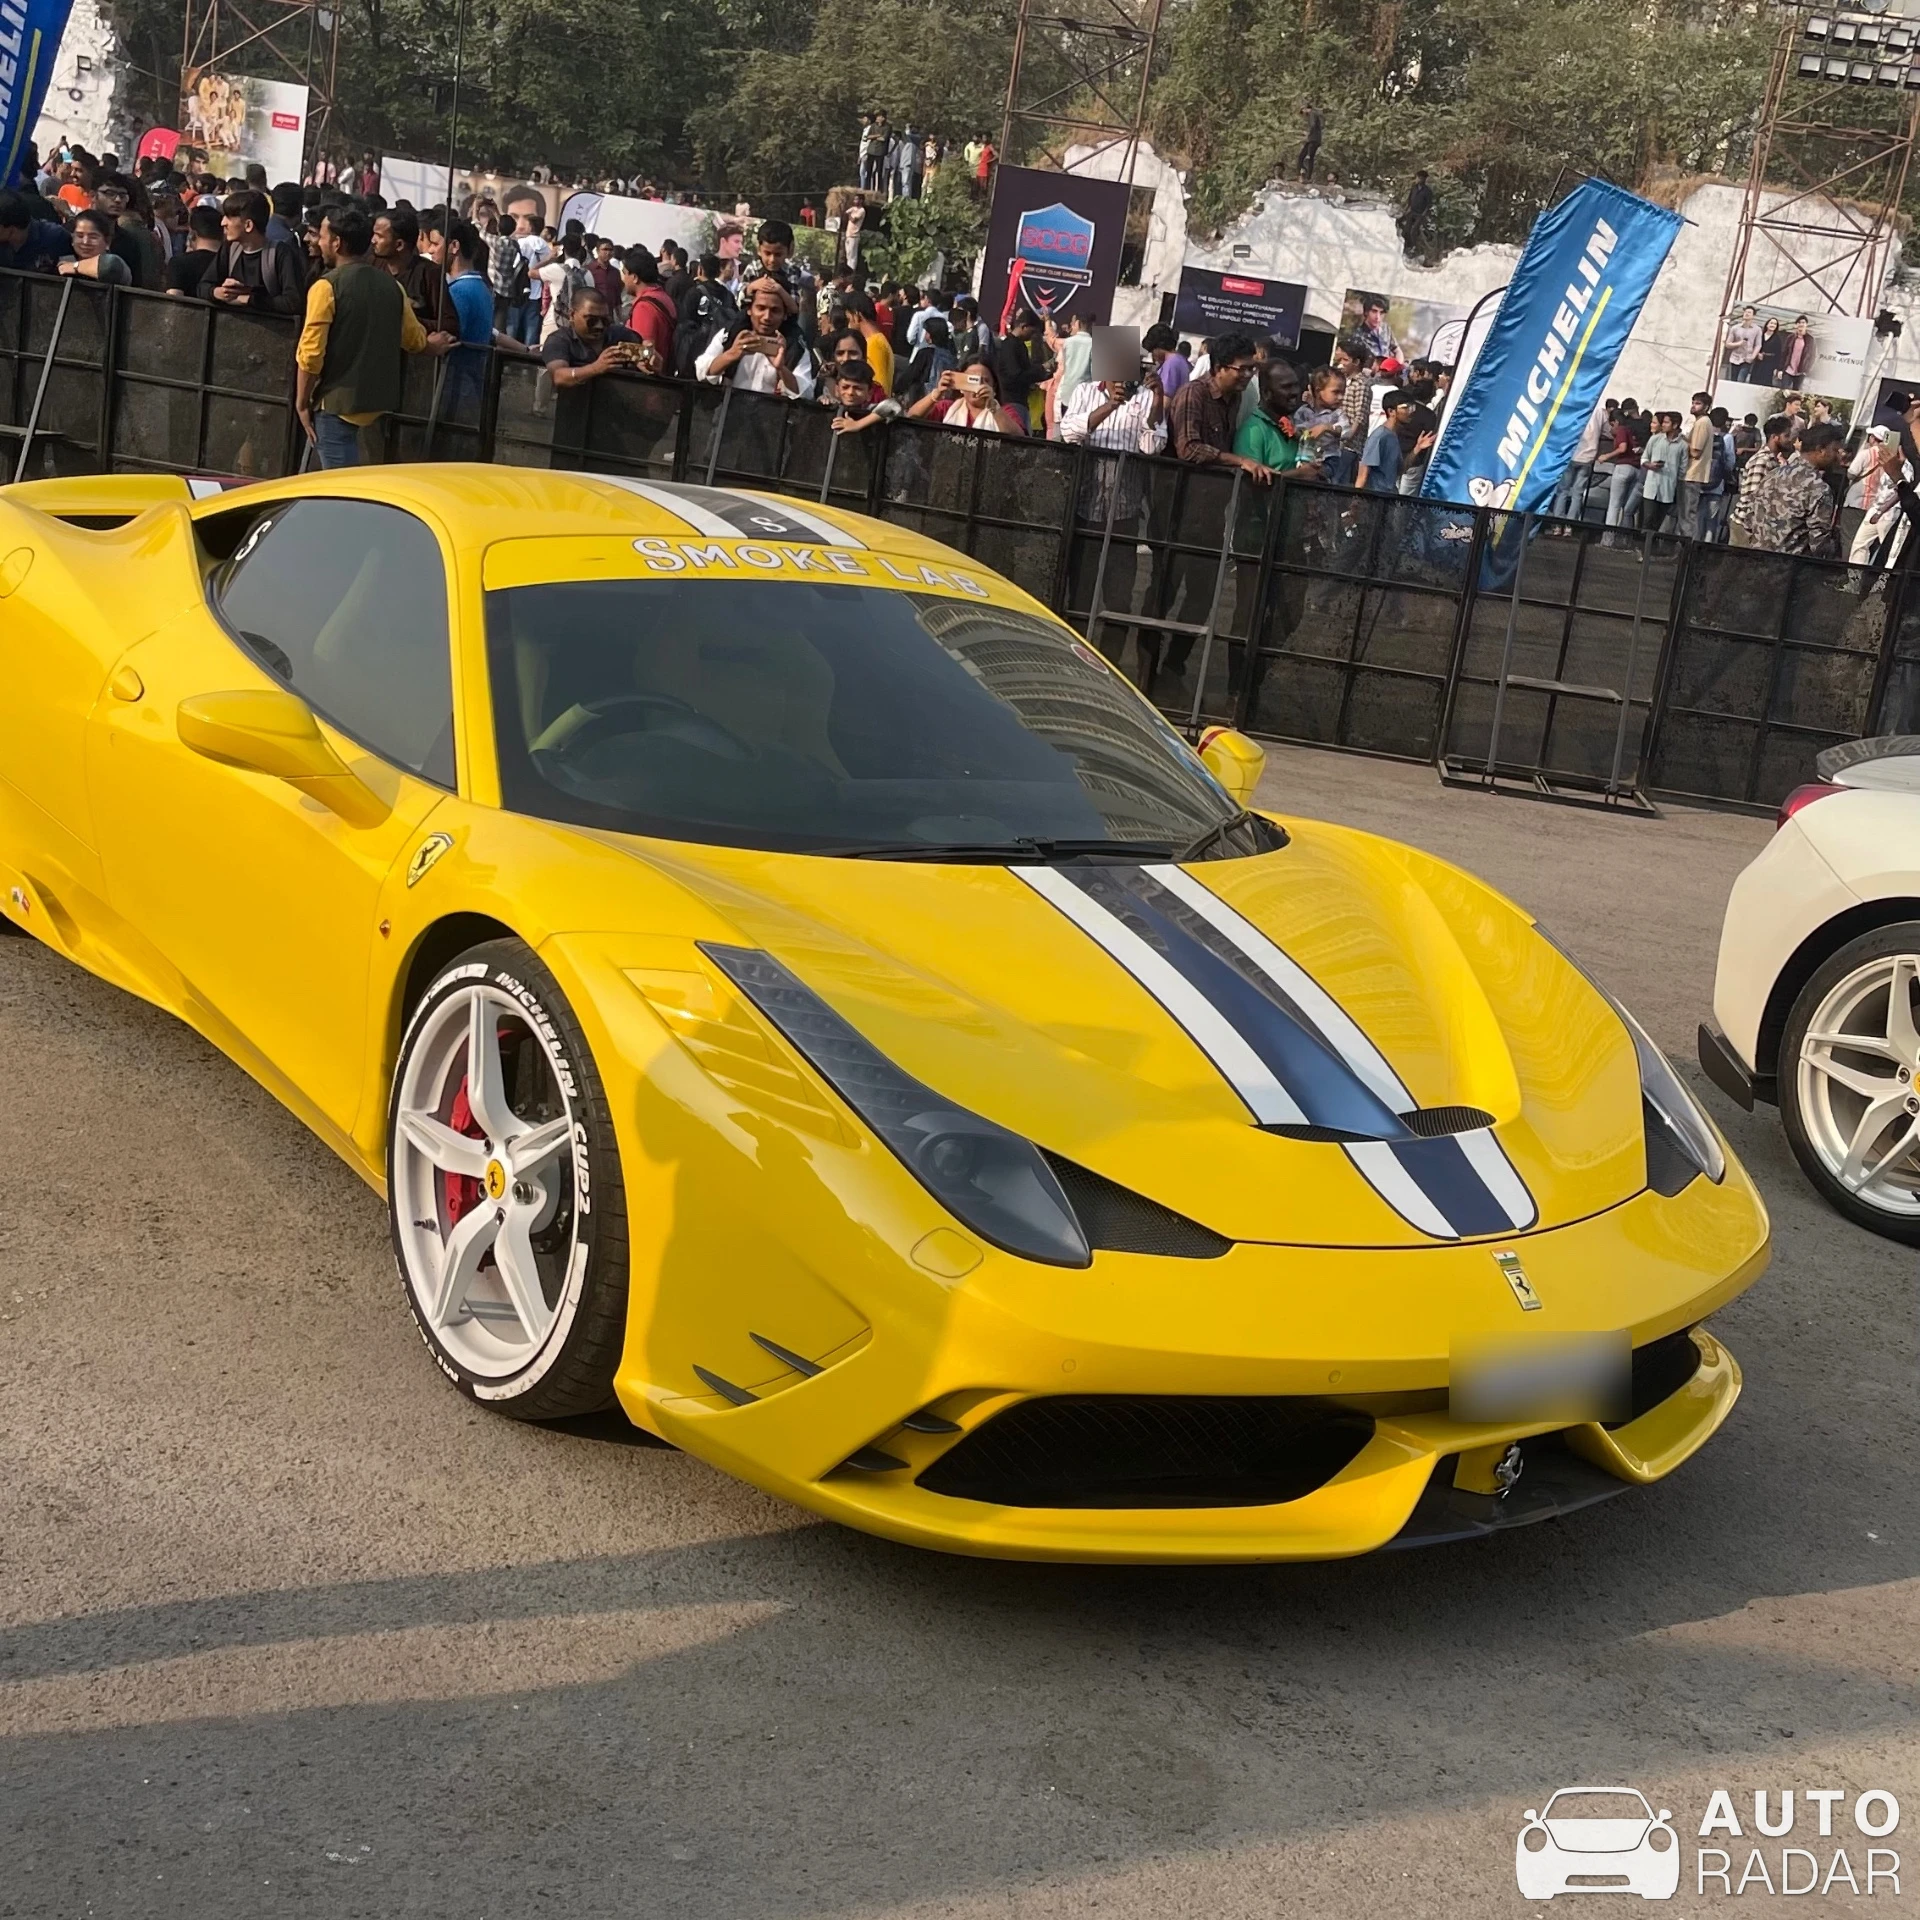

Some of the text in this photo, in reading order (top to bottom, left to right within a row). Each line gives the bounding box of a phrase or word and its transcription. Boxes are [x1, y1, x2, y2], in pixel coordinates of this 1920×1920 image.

[1021, 226, 1089, 256] SCCG
[1497, 217, 1619, 471] MICHELIN
[1819, 353, 1864, 367] PARK AVENUE
[632, 537, 990, 598] SMOKE LAB
[494, 971, 578, 1098] MICHELIN
